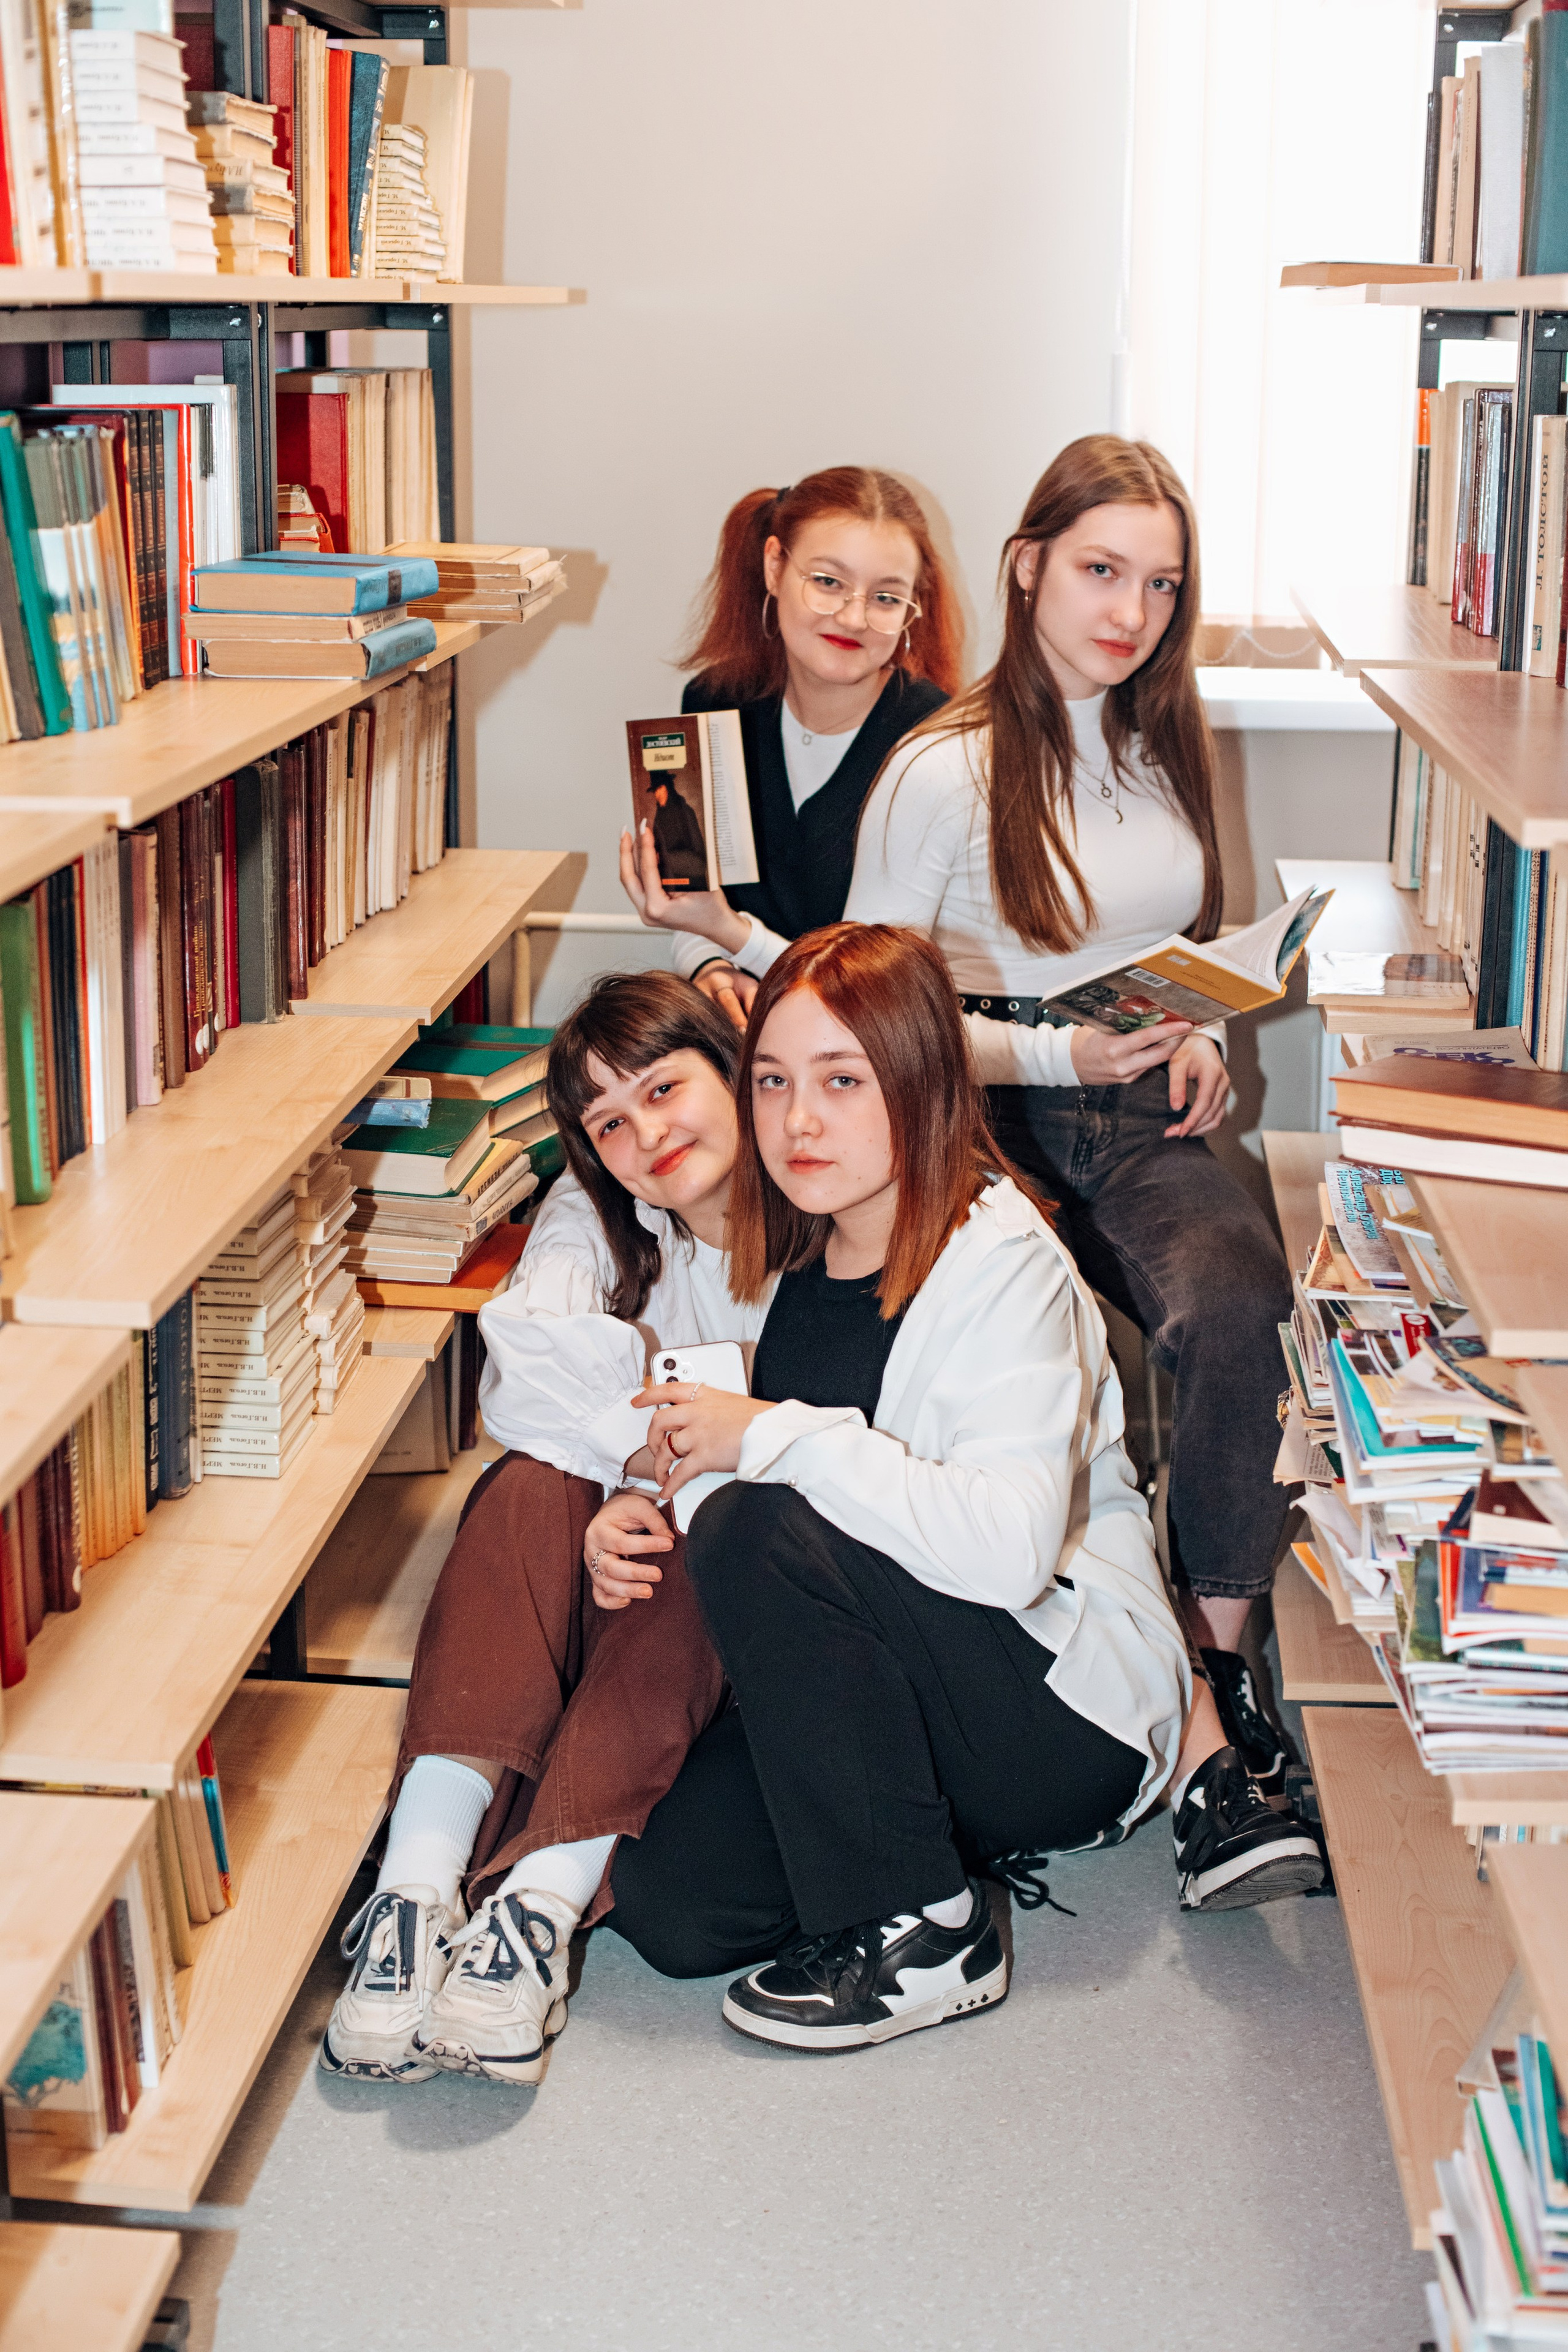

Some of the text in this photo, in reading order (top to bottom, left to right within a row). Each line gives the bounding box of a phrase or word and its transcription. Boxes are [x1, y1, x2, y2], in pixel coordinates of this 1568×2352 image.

[1536, 454, 1548, 589] Л. ТОЛСТОЙ
[1349, 1169, 1368, 1212] Александр
